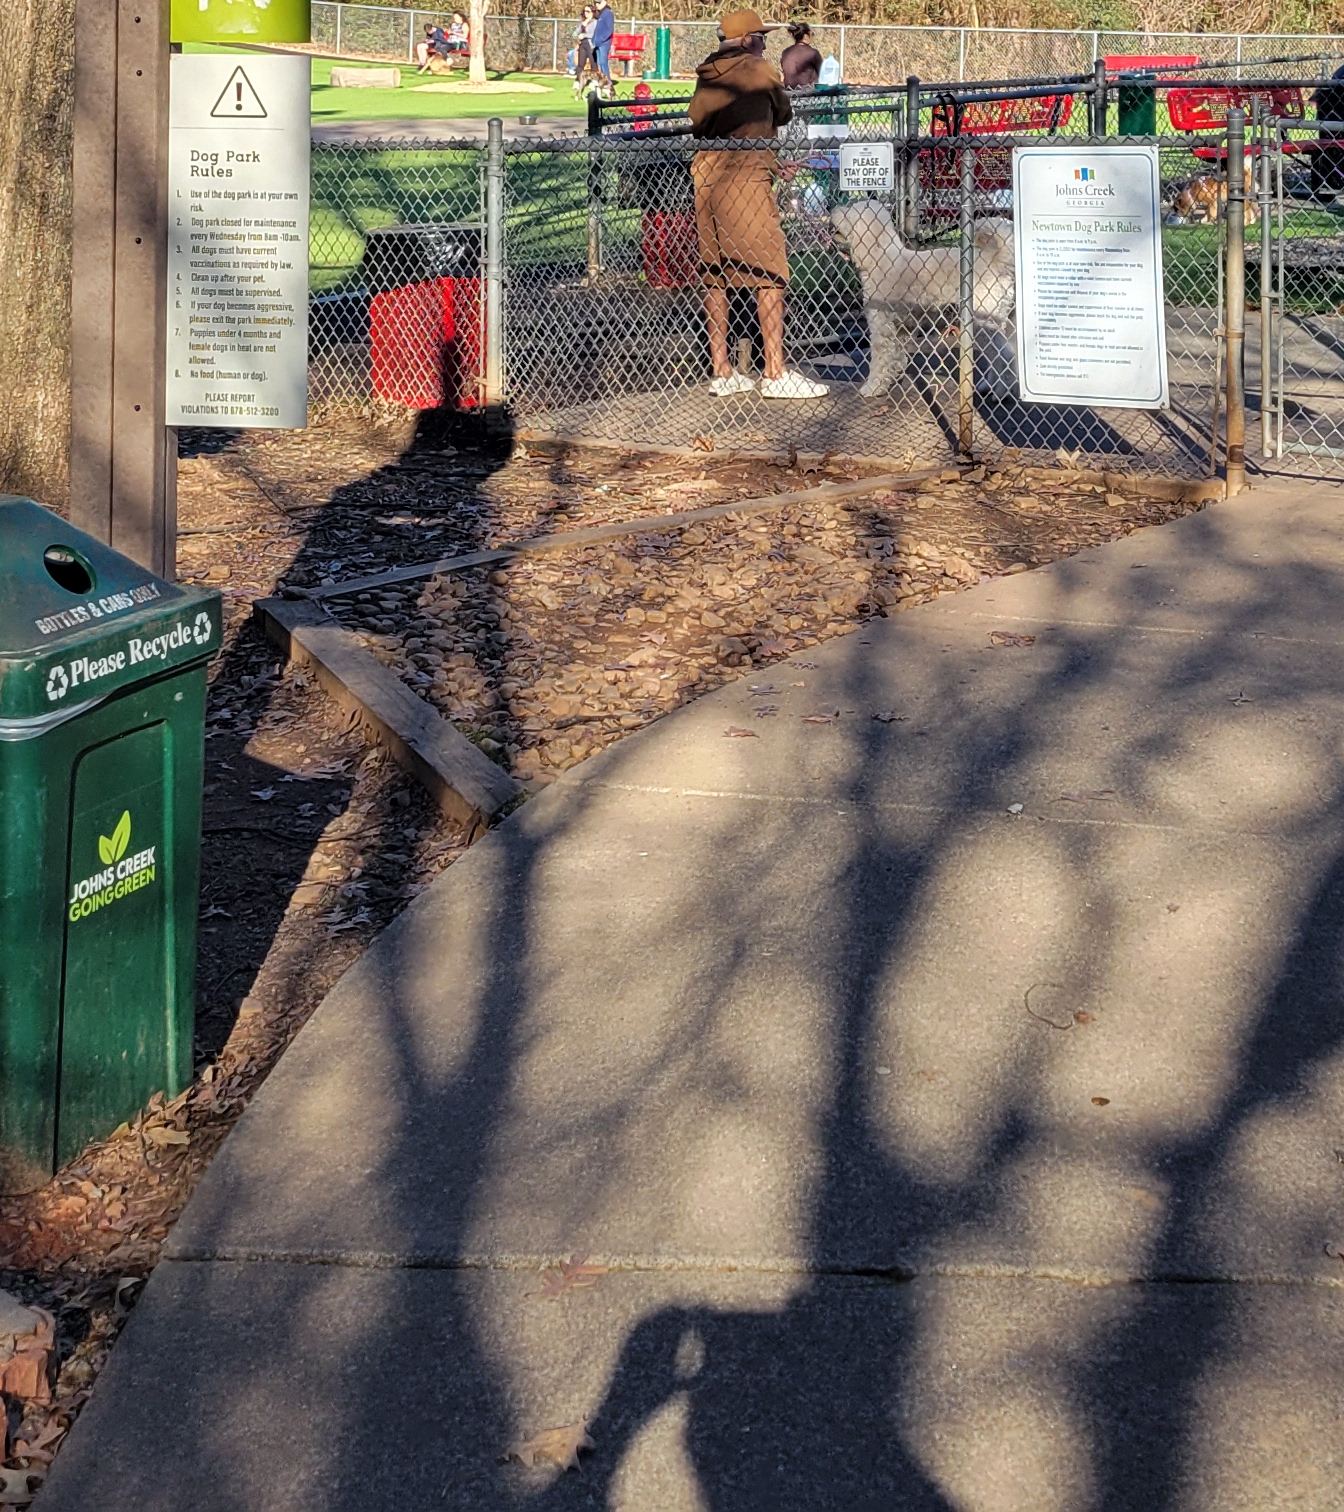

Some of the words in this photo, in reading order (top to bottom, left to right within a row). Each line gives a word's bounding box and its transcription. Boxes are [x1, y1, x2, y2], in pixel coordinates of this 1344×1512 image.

[190, 150, 218, 165] Dog
[226, 151, 260, 162] Park
[853, 158, 879, 166] PLEASE
[190, 165, 233, 177] Rules
[844, 168, 860, 176] STAY
[862, 168, 877, 176] OFF
[879, 168, 889, 176] OF
[847, 178, 860, 186] THE
[863, 178, 886, 186] FENCE
[191, 190, 202, 198] Use
[204, 190, 210, 198] of
[212, 190, 221, 199] the
[224, 190, 235, 200] dog
[237, 191, 251, 200] park
[253, 191, 258, 199] is
[260, 191, 266, 199] at
[268, 193, 282, 201] your
[1056, 184, 1082, 197] Johns
[1085, 184, 1115, 196] Creek
[177, 218, 182, 226] 2.
[192, 218, 203, 228] Dog
[206, 218, 219, 227] park
[221, 218, 241, 226] closed
[244, 218, 252, 226] for
[254, 219, 296, 227] maintenance
[1031, 219, 1073, 232] Newtown
[1075, 221, 1092, 235] Dog
[1094, 221, 1114, 232] Park
[1117, 221, 1142, 232] Rules
[190, 233, 208, 242] every
[210, 232, 246, 242] Wednesday
[202, 246, 217, 256] dogs
[236, 246, 251, 254] have
[253, 247, 276, 255] current
[190, 260, 231, 268] vaccinations
[242, 261, 268, 270] required
[270, 261, 278, 270] by
[280, 261, 293, 269] law.
[191, 273, 209, 281] Clean
[211, 275, 218, 283] up
[220, 274, 235, 282] after
[237, 275, 251, 283] your
[253, 275, 265, 284] pet.
[201, 288, 216, 297] dogs
[218, 288, 234, 296] must
[245, 289, 282, 297] supervised.
[197, 303, 212, 311] your
[213, 302, 225, 311] dog
[227, 302, 255, 310] becomes
[257, 303, 294, 312] aggressive,
[190, 314, 210, 323] please
[226, 316, 235, 324] the
[238, 316, 252, 325] park
[254, 316, 295, 326] immediately.
[190, 329, 215, 338] Puppies
[243, 330, 267, 338] months
[269, 330, 281, 338] and
[189, 342, 210, 351] female
[213, 343, 228, 353] dogs
[230, 343, 235, 351] in
[238, 344, 252, 352] heat
[189, 356, 216, 364] allowed.
[190, 370, 198, 378] No
[200, 370, 214, 378] food
[216, 370, 241, 380] (human
[251, 372, 268, 382] dog).
[205, 393, 228, 402] PLEASE
[231, 394, 255, 402] REPORT
[181, 406, 218, 414] VIOLATIONS
[222, 406, 228, 414] TO
[35, 606, 90, 634] BOTTLES
[88, 602, 104, 618] &
[99, 592, 134, 614] CANS
[129, 582, 161, 603] ONLY
[70, 651, 126, 687] Please
[128, 622, 191, 665] Recycle
[70, 867, 114, 903] JOHNS
[117, 846, 155, 879] CREEK
